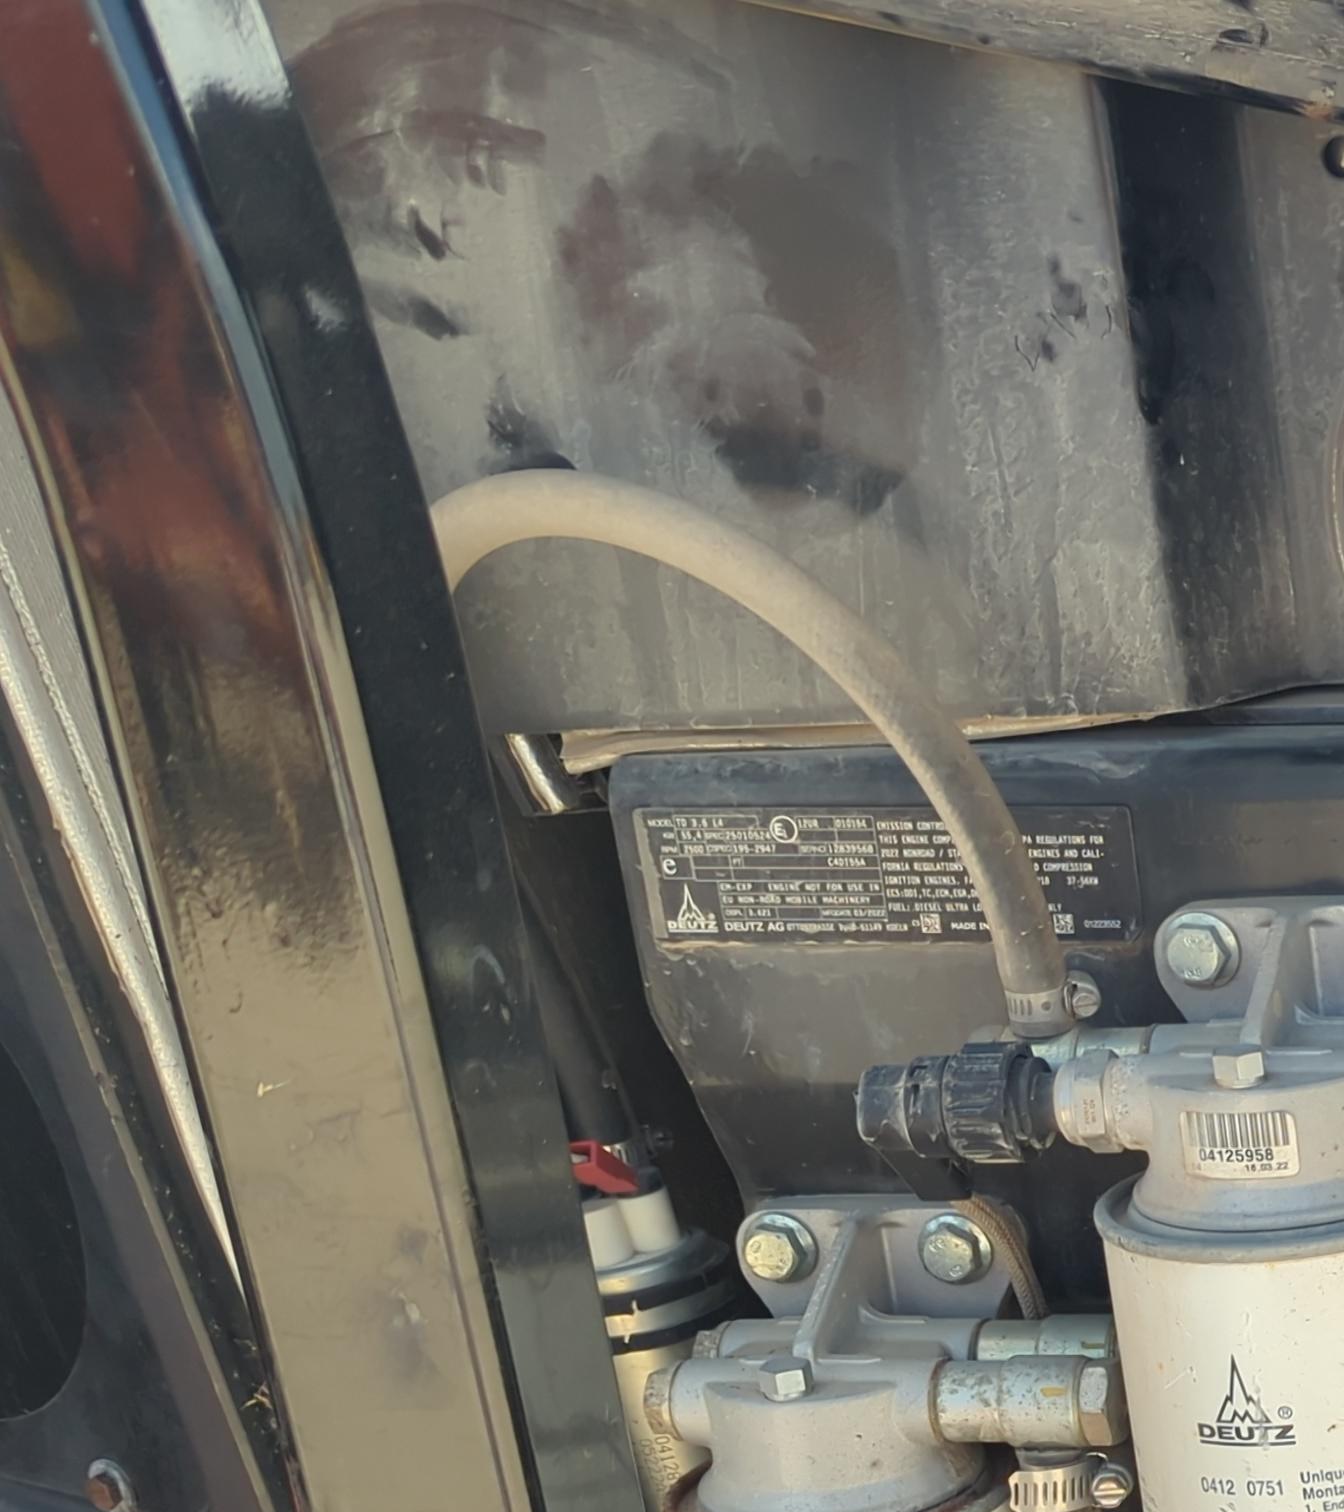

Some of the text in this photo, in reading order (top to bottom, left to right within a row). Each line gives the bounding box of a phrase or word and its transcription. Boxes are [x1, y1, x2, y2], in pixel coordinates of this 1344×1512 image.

[901, 834, 930, 845] ENGINE
[1035, 835, 1086, 844] REGULATIONS
[913, 861, 964, 872] REGULATIONS
[804, 883, 821, 892] NOT
[826, 883, 843, 892] FOR
[847, 883, 864, 892] USE
[666, 920, 719, 930] DEUTZ
[724, 921, 765, 932] DEUTZ
[767, 922, 785, 932] AG
[950, 921, 977, 931] MADE
[1199, 1147, 1275, 1164] 04125958
[1197, 1422, 1297, 1442] DEUTZ
[1200, 1476, 1285, 1497] 0412 0751
